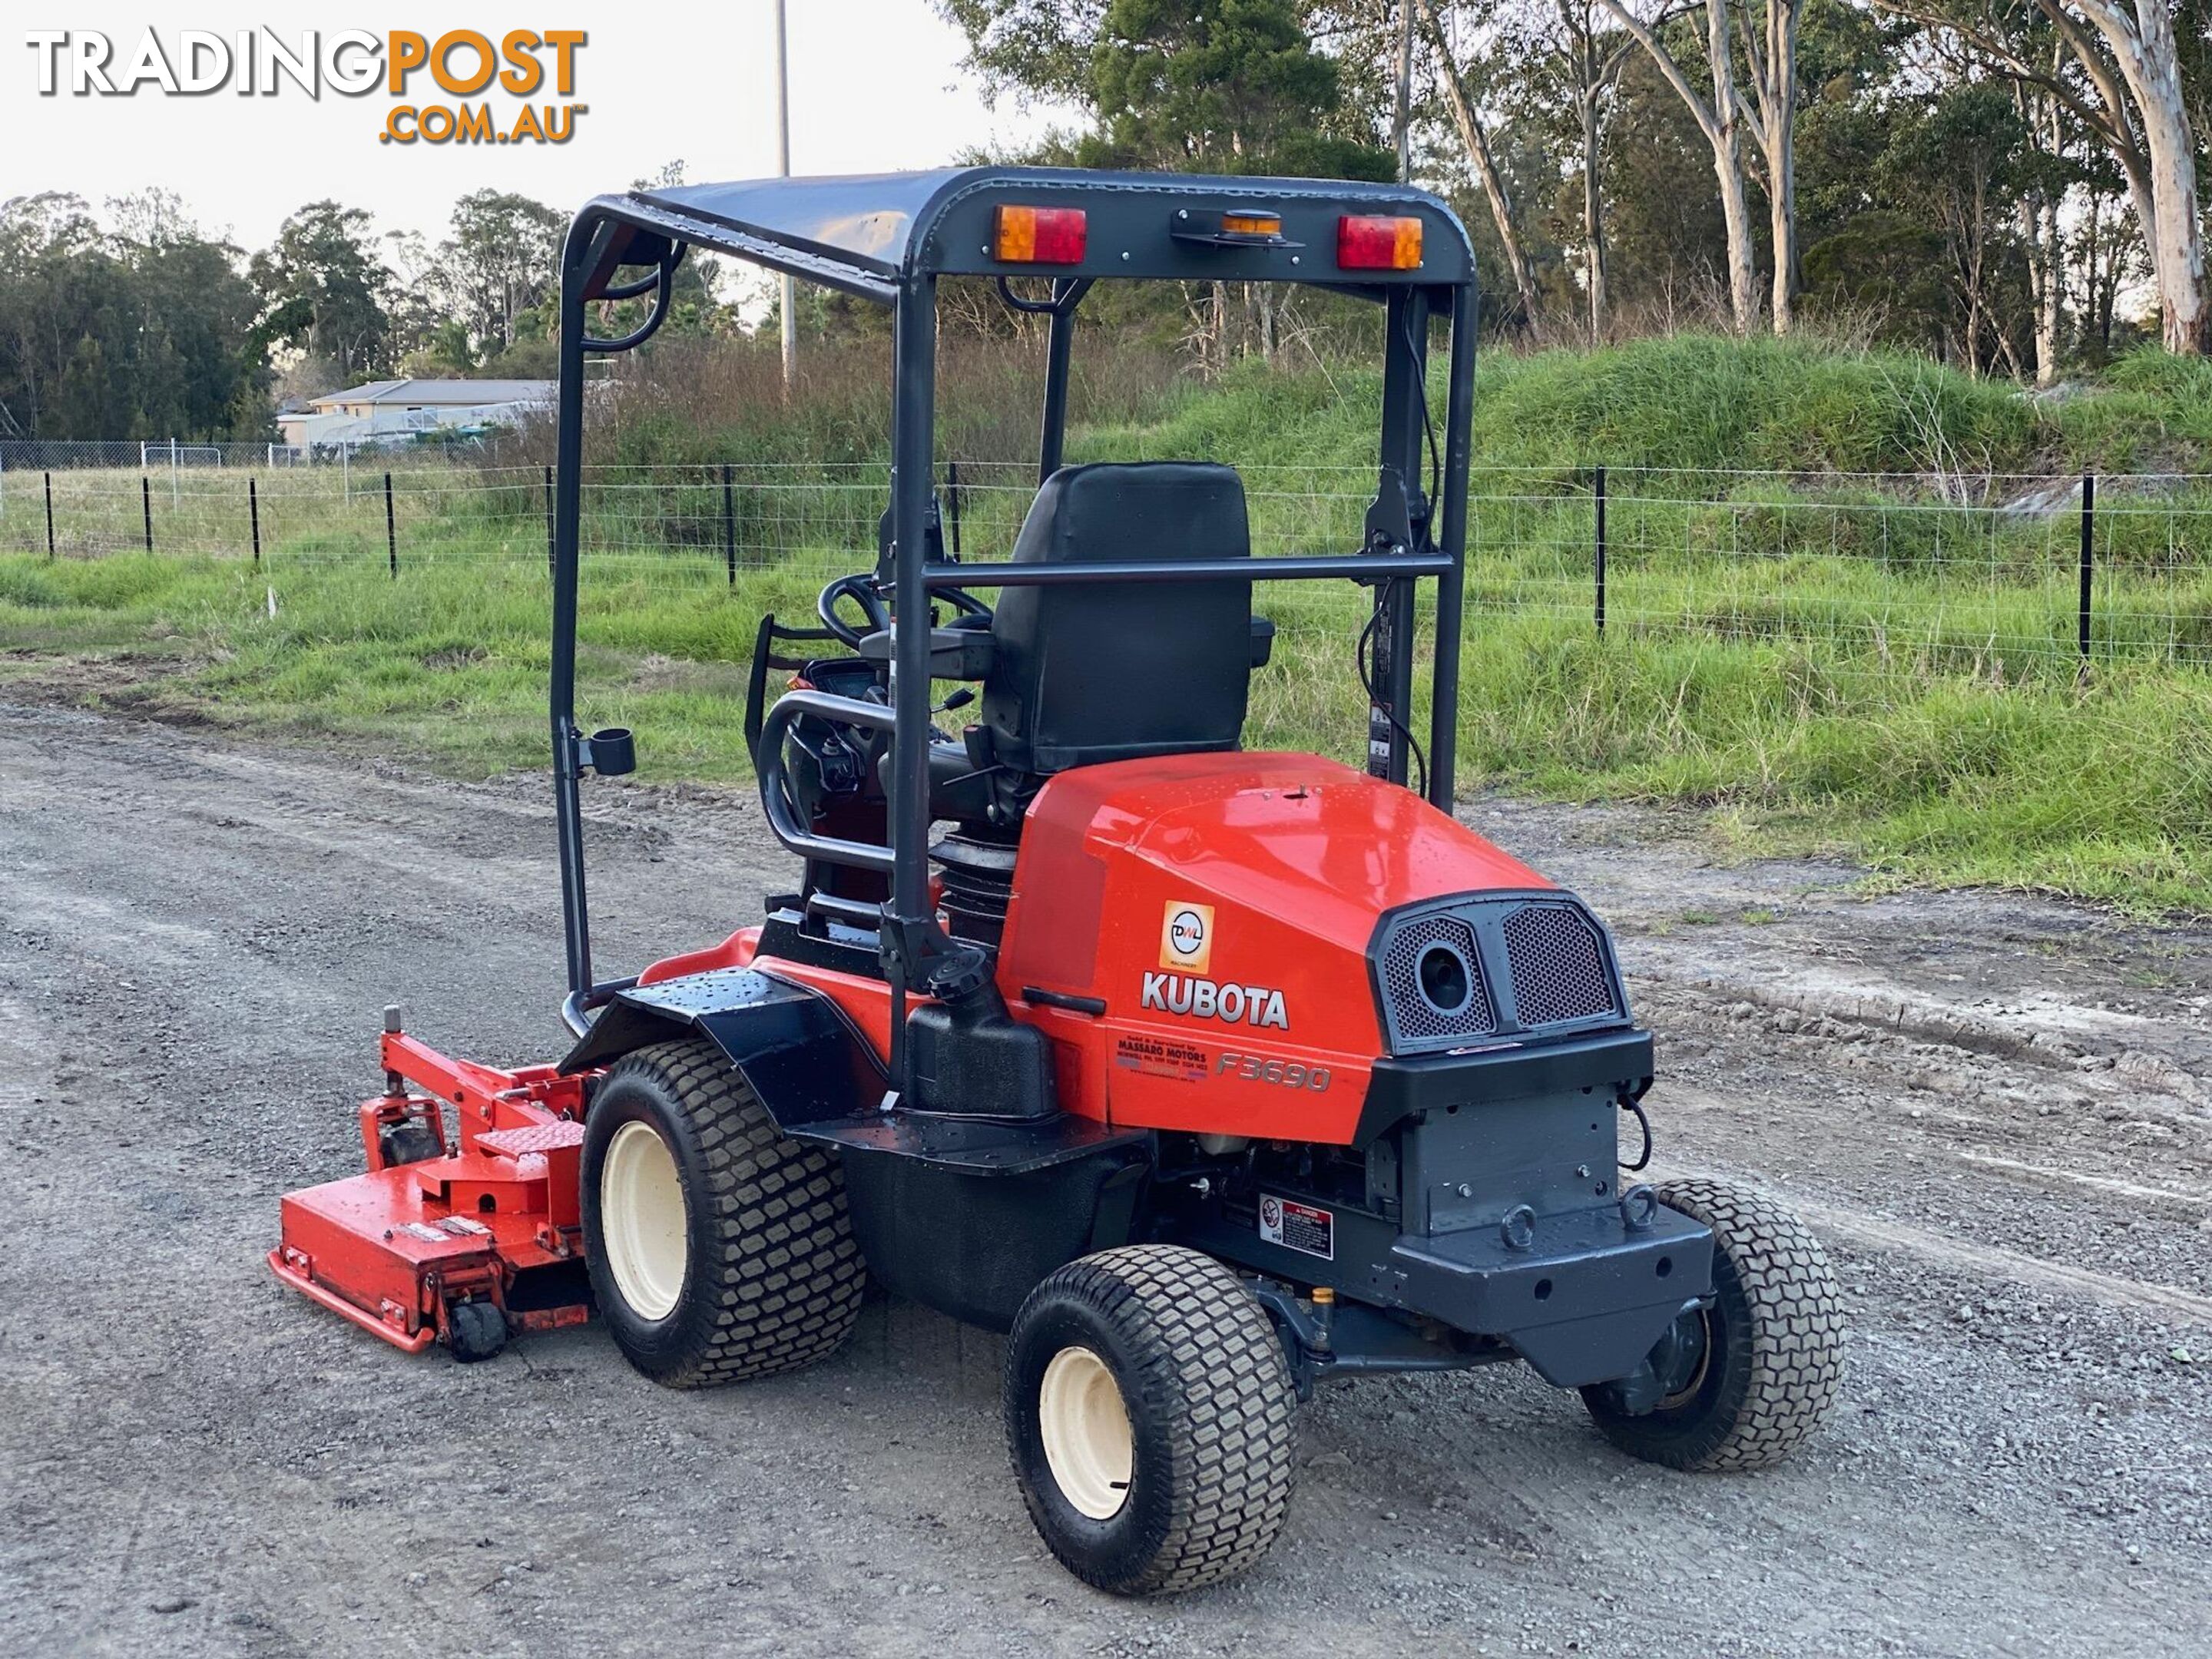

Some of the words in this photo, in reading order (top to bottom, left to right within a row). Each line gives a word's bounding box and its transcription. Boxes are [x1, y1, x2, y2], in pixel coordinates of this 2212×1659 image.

[1141, 971, 1289, 1030] KUBOTA
[1118, 1040, 1164, 1056] MASSARO
[1167, 1048, 1207, 1062] MOTORS
[1217, 1052, 1330, 1092] F3690
